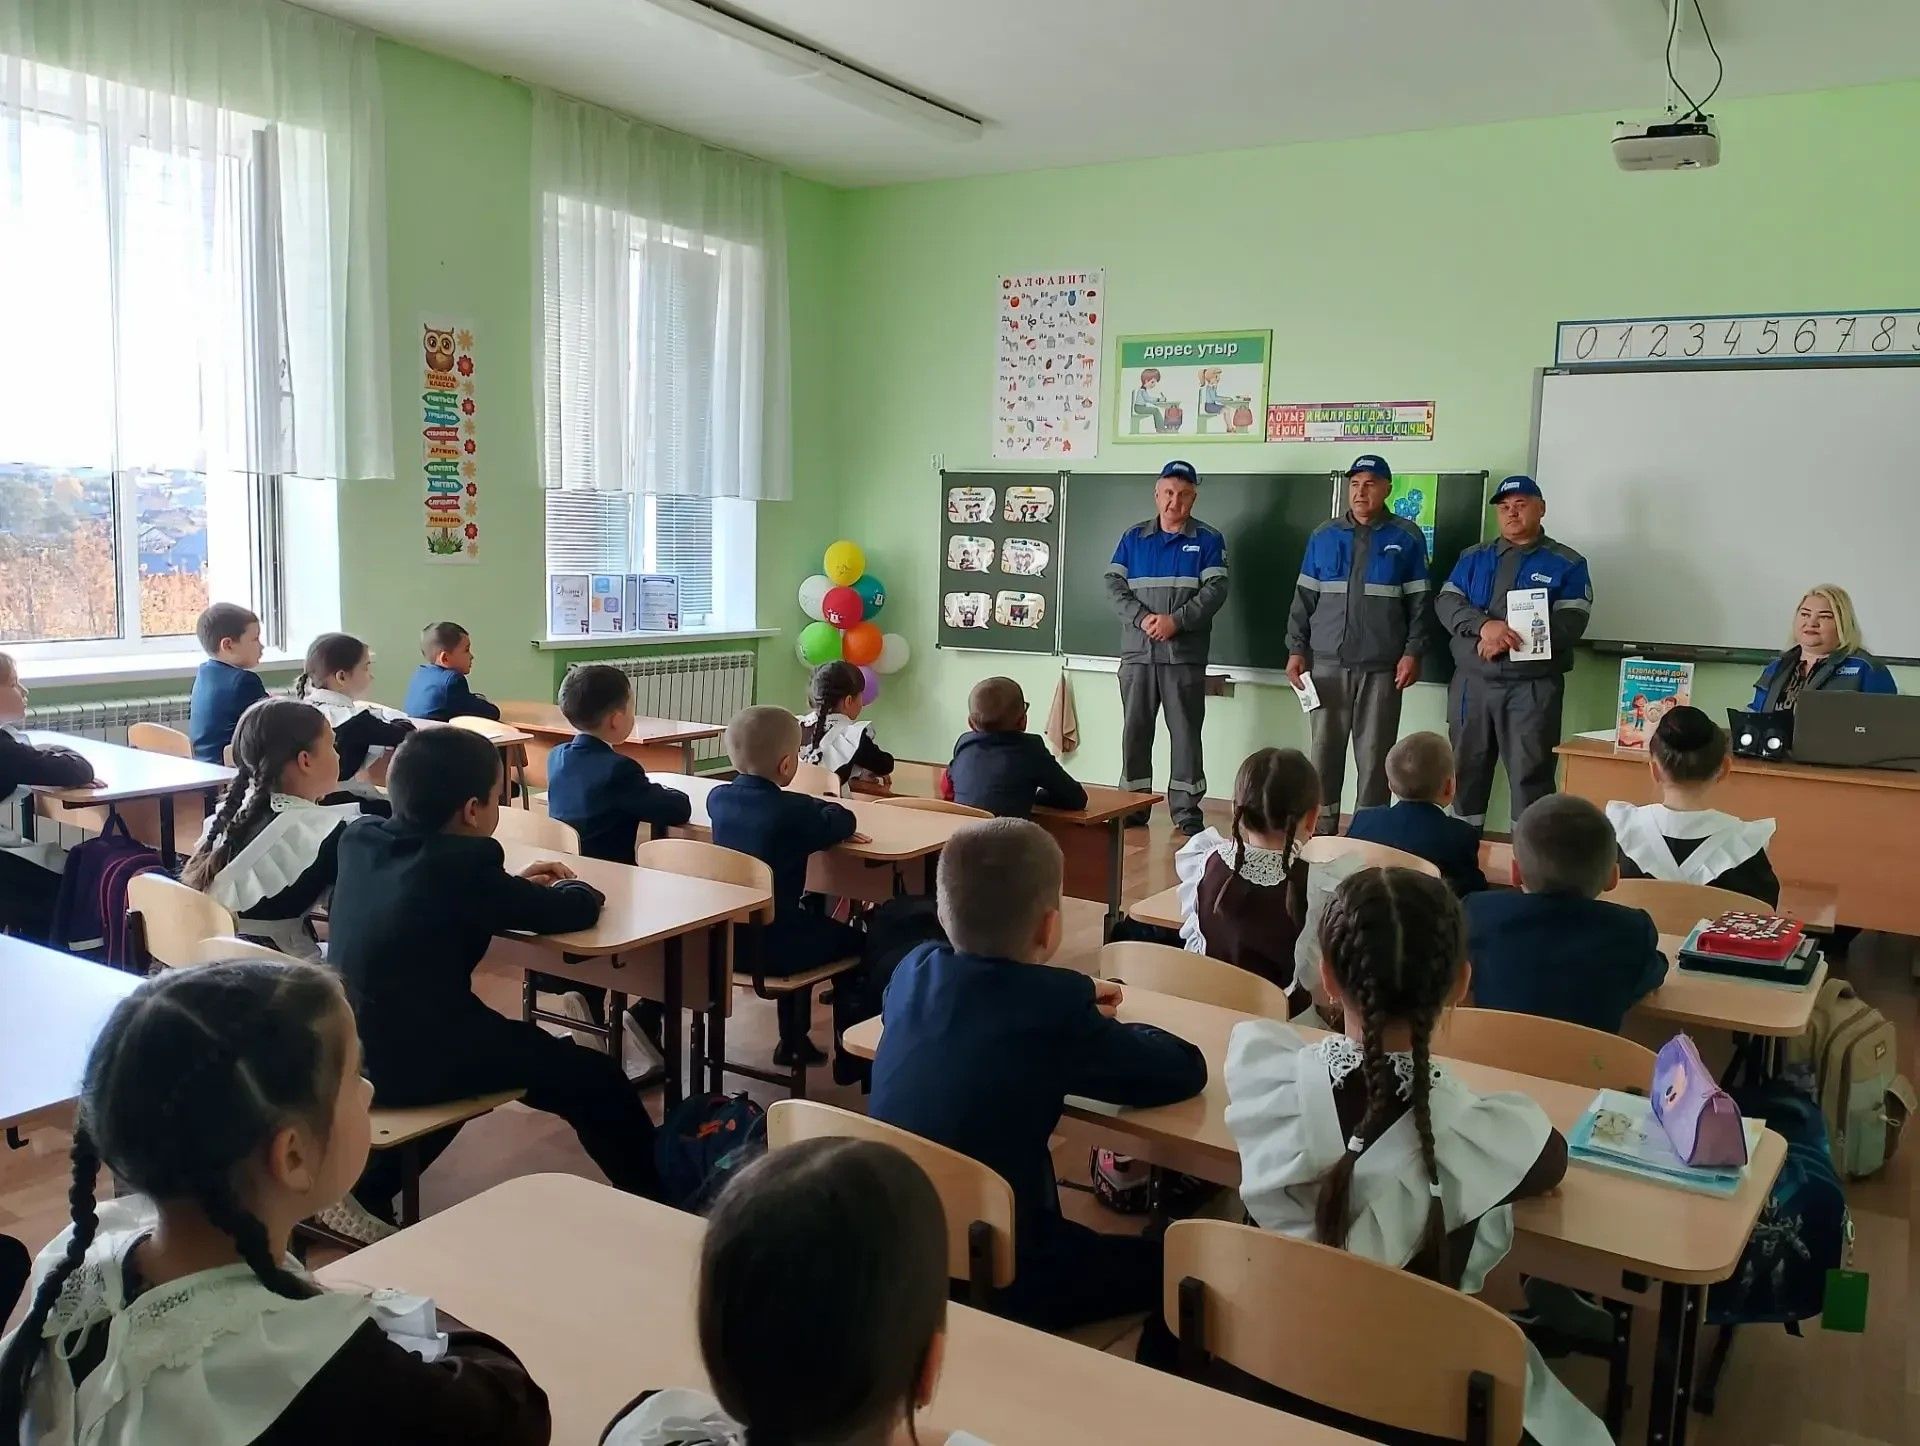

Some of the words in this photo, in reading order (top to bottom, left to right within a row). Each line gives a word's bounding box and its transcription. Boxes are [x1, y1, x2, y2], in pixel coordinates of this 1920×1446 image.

[1144, 344, 1193, 359] дөрес
[1198, 343, 1238, 359] утыр
[1576, 326, 1598, 360] 0
[1617, 325, 1634, 359] 1
[1648, 324, 1669, 358] 2
[1683, 322, 1706, 357] 3
[1723, 320, 1742, 356] 4
[1756, 319, 1780, 354] 5
[1793, 318, 1817, 353] 6
[1835, 317, 1857, 353] 7
[1871, 315, 1897, 352] 8
